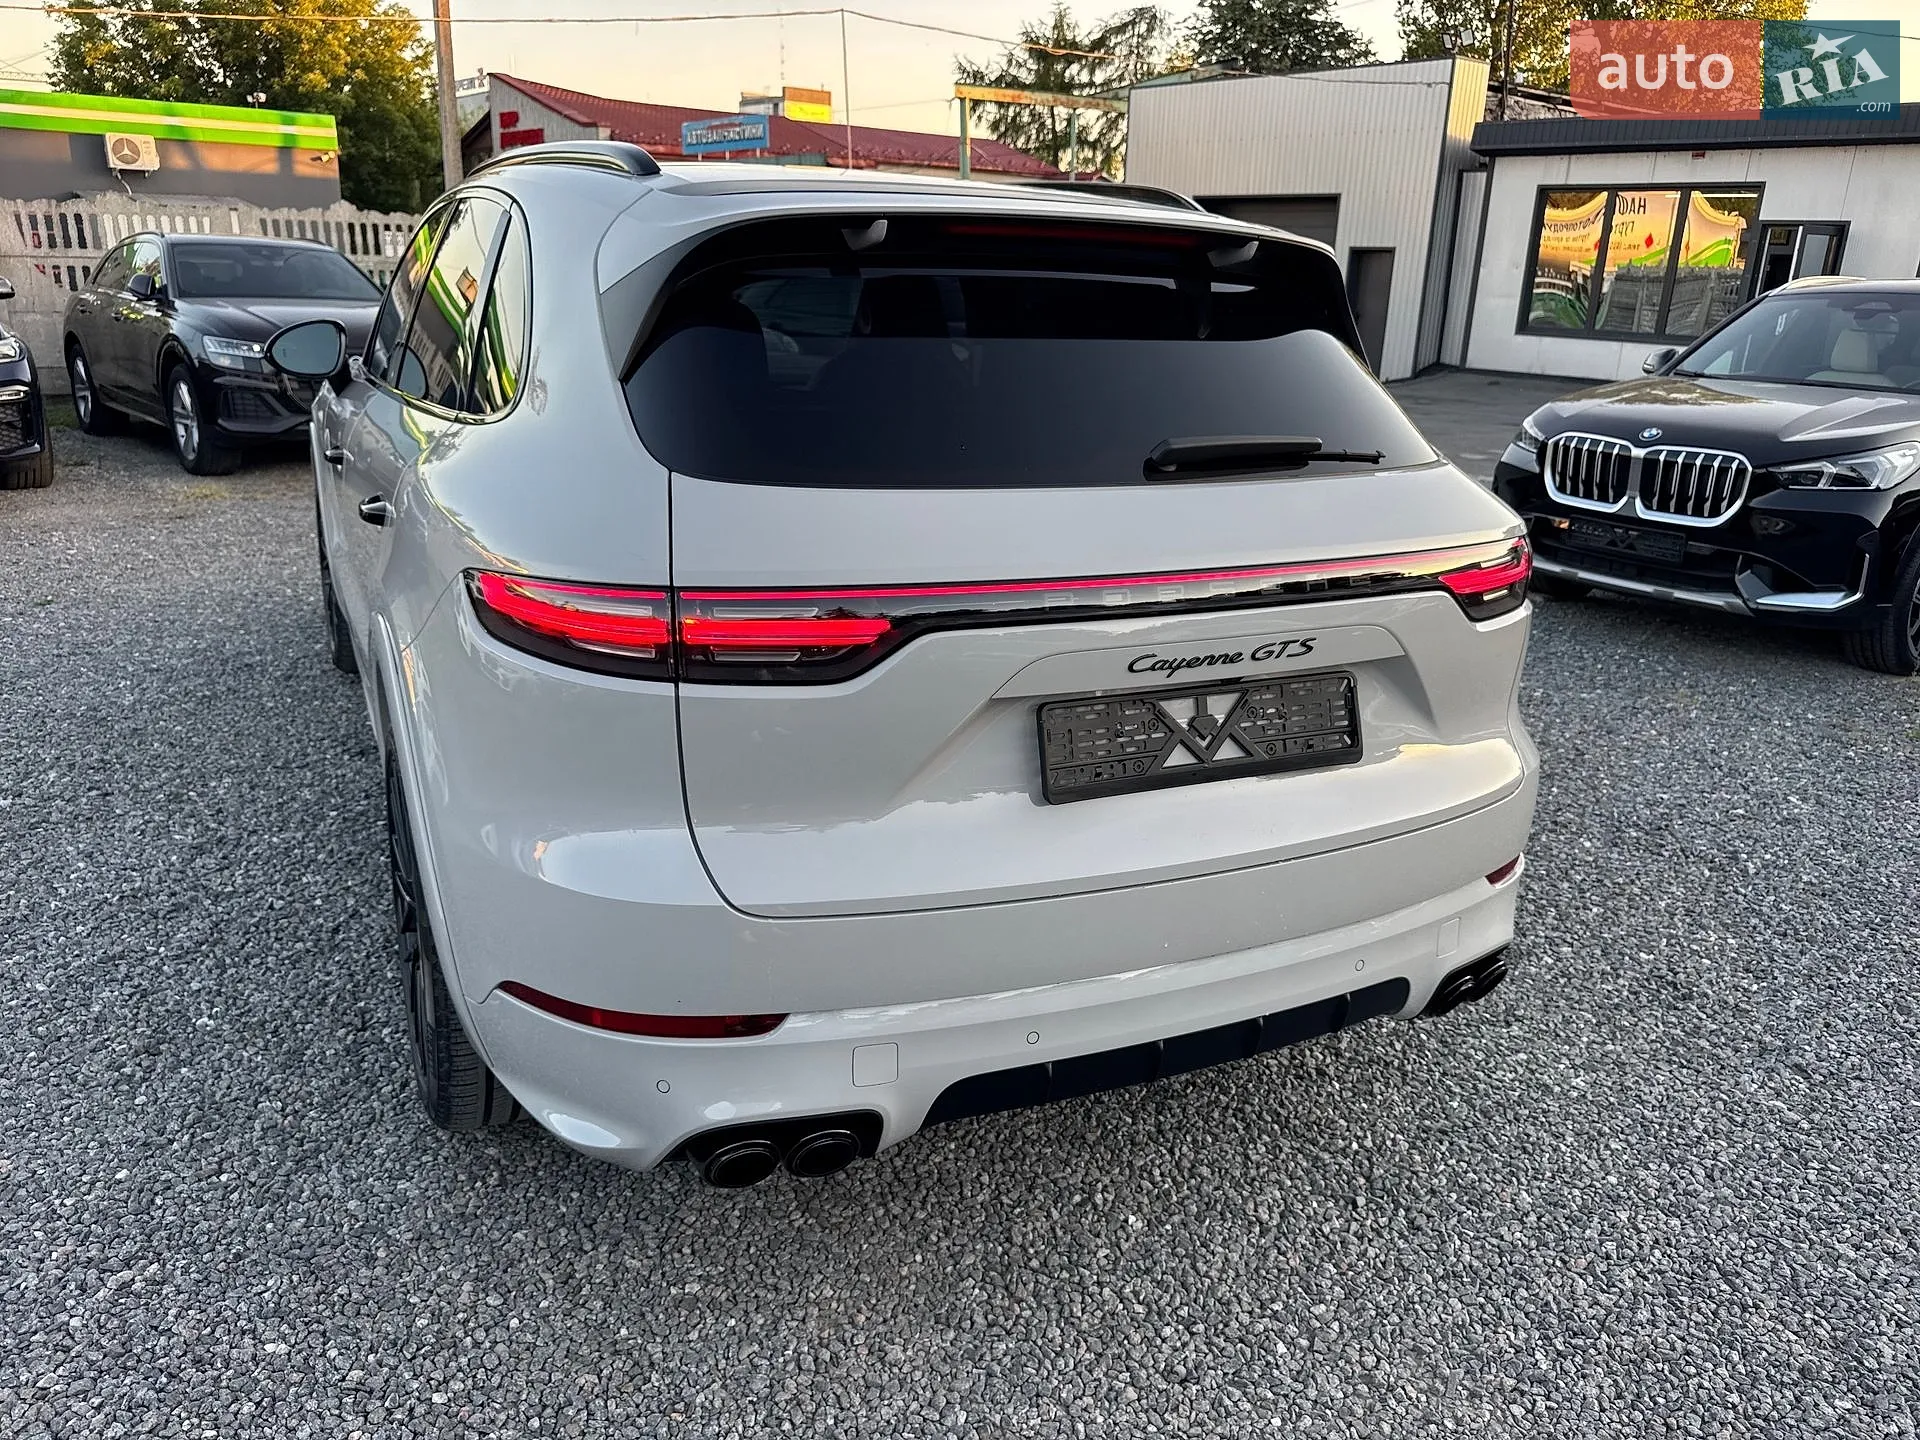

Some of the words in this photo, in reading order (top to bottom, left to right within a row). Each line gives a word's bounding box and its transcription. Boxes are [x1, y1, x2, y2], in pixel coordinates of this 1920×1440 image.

[1043, 572, 1372, 611] PORSCHE
[1127, 650, 1245, 679] Cayenne
[1250, 637, 1317, 662] GTS
